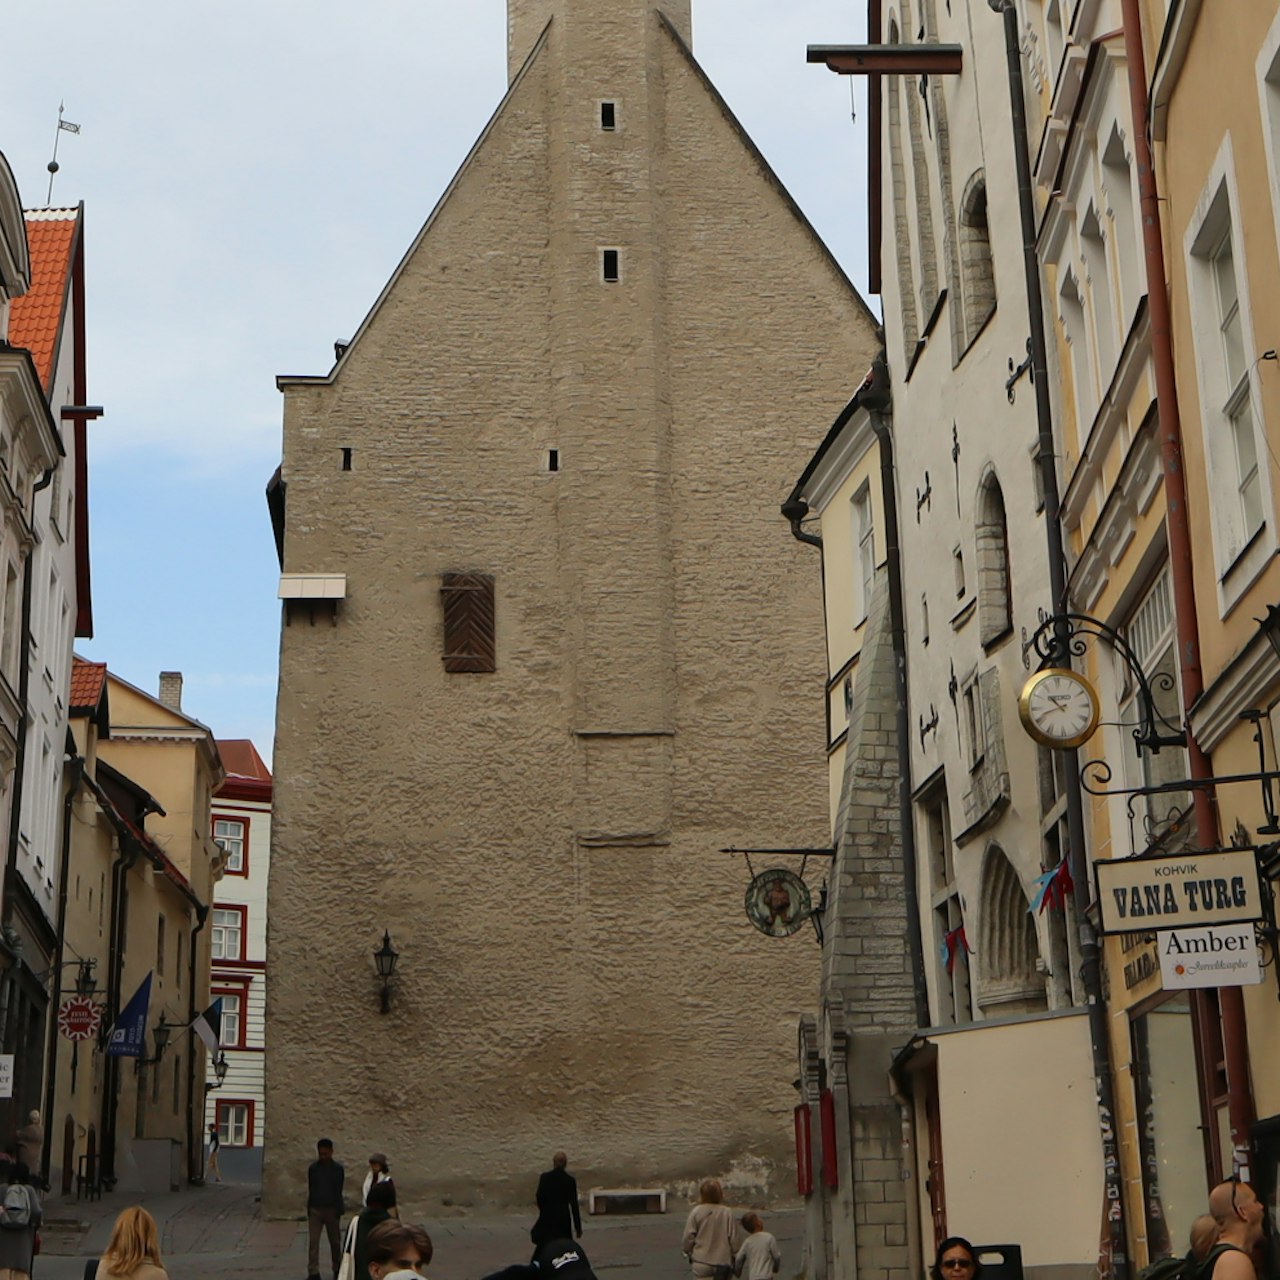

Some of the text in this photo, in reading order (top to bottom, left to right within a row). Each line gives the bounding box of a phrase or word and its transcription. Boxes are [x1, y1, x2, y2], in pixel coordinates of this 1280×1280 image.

[1154, 864, 1198, 877] KOHVIK
[1113, 876, 1246, 918] VANA TURG
[1166, 930, 1249, 955] Amber
